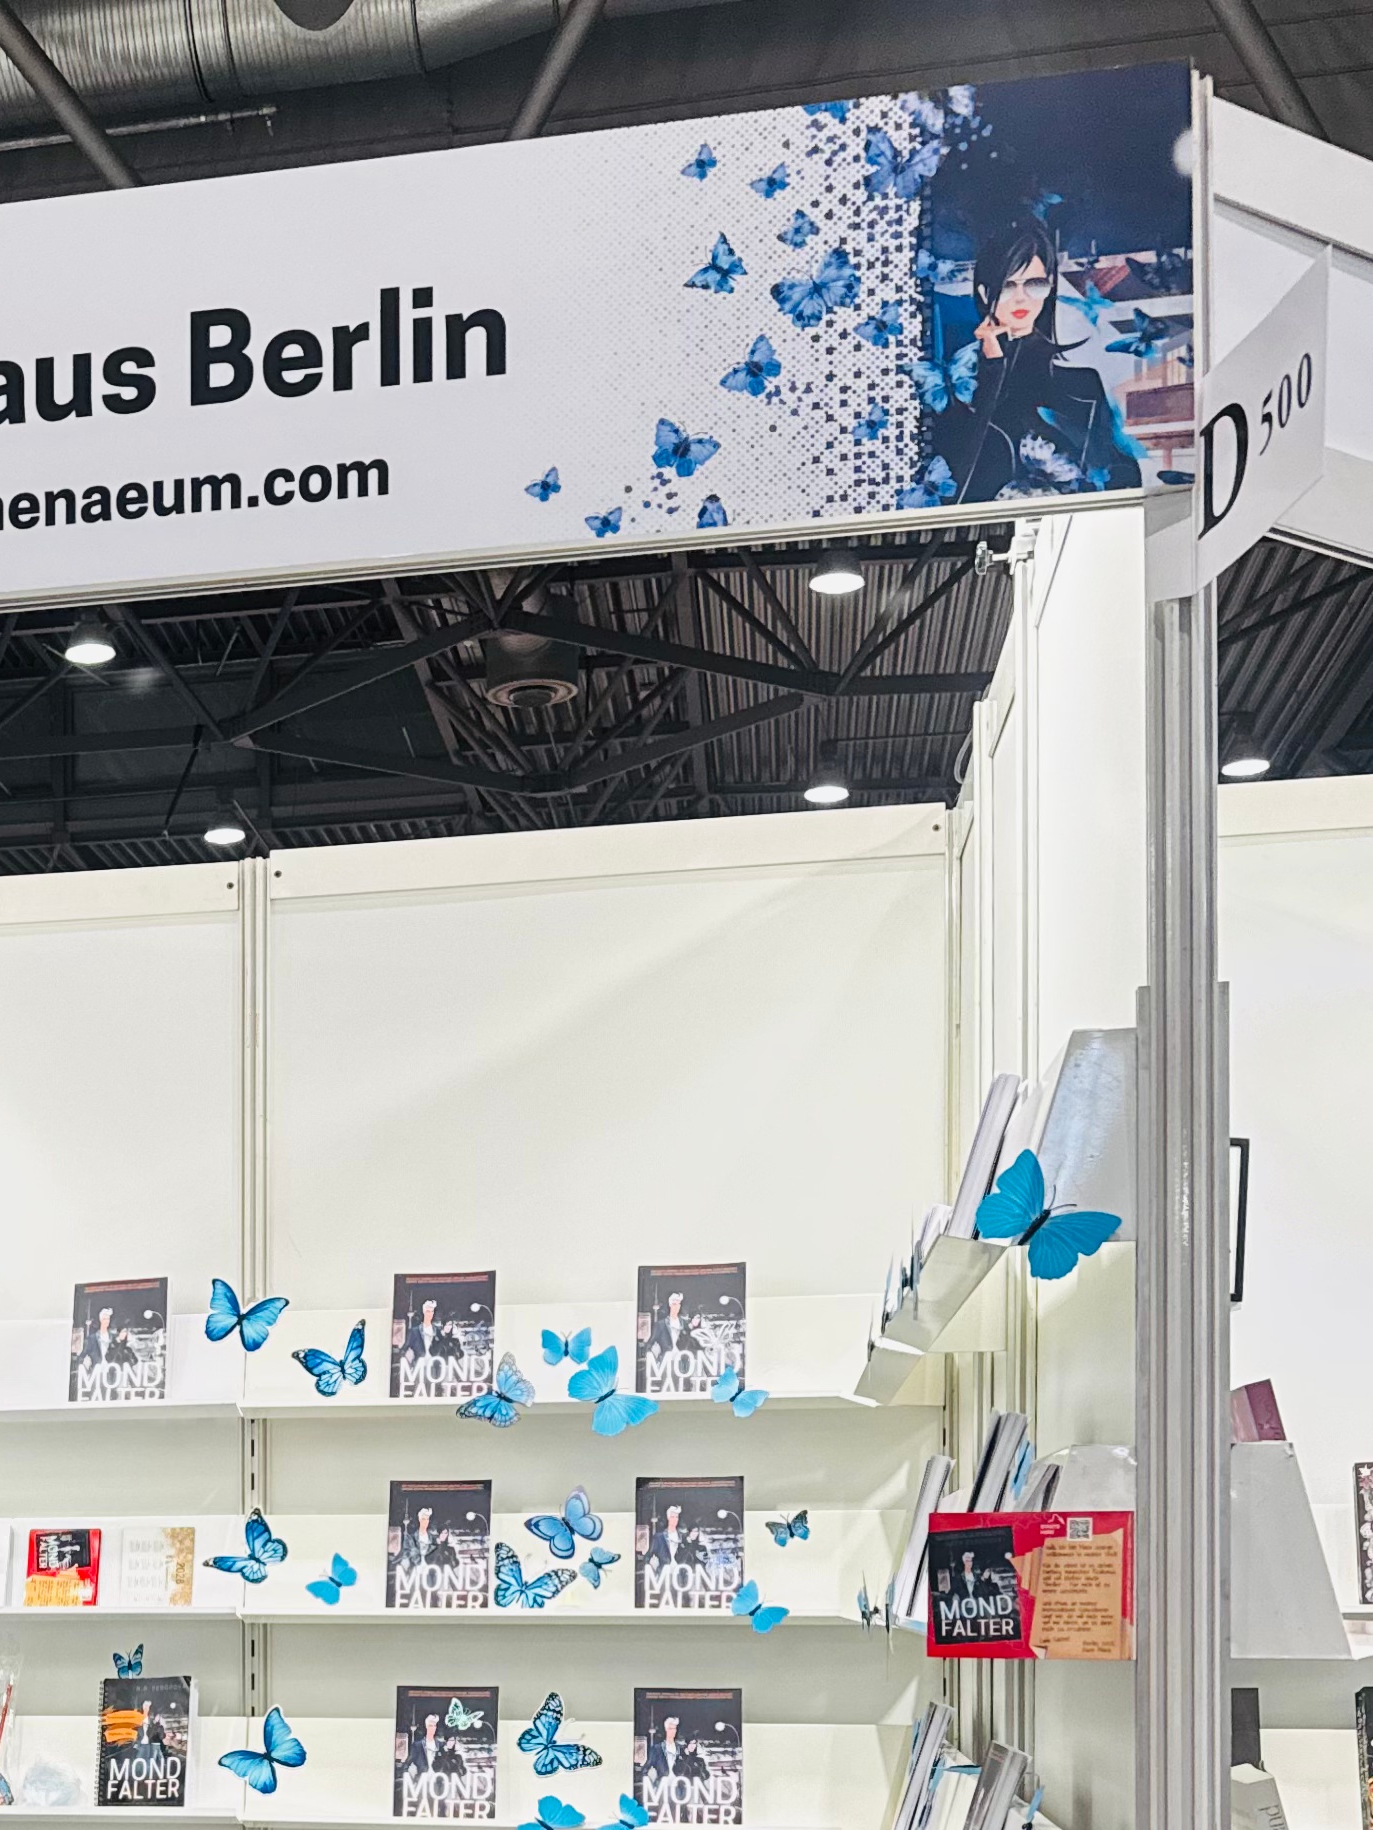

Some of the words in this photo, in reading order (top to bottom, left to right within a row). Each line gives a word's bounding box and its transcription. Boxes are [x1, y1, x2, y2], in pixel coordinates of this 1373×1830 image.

[190, 287, 507, 406] Berlin
[1198, 402, 1249, 540] D
[1259, 352, 1313, 456] 500
[77, 1361, 162, 1391] MOND
[399, 1355, 489, 1384] MOND
[395, 1563, 485, 1592] MOND
[644, 1563, 739, 1592] MOND
[939, 1594, 1013, 1620] MOND
[941, 1619, 1015, 1637] FALTER
[109, 1756, 182, 1781] MOND
[107, 1779, 180, 1800] FALTER
[402, 1771, 492, 1801] MOND
[642, 1775, 738, 1805] MOND
